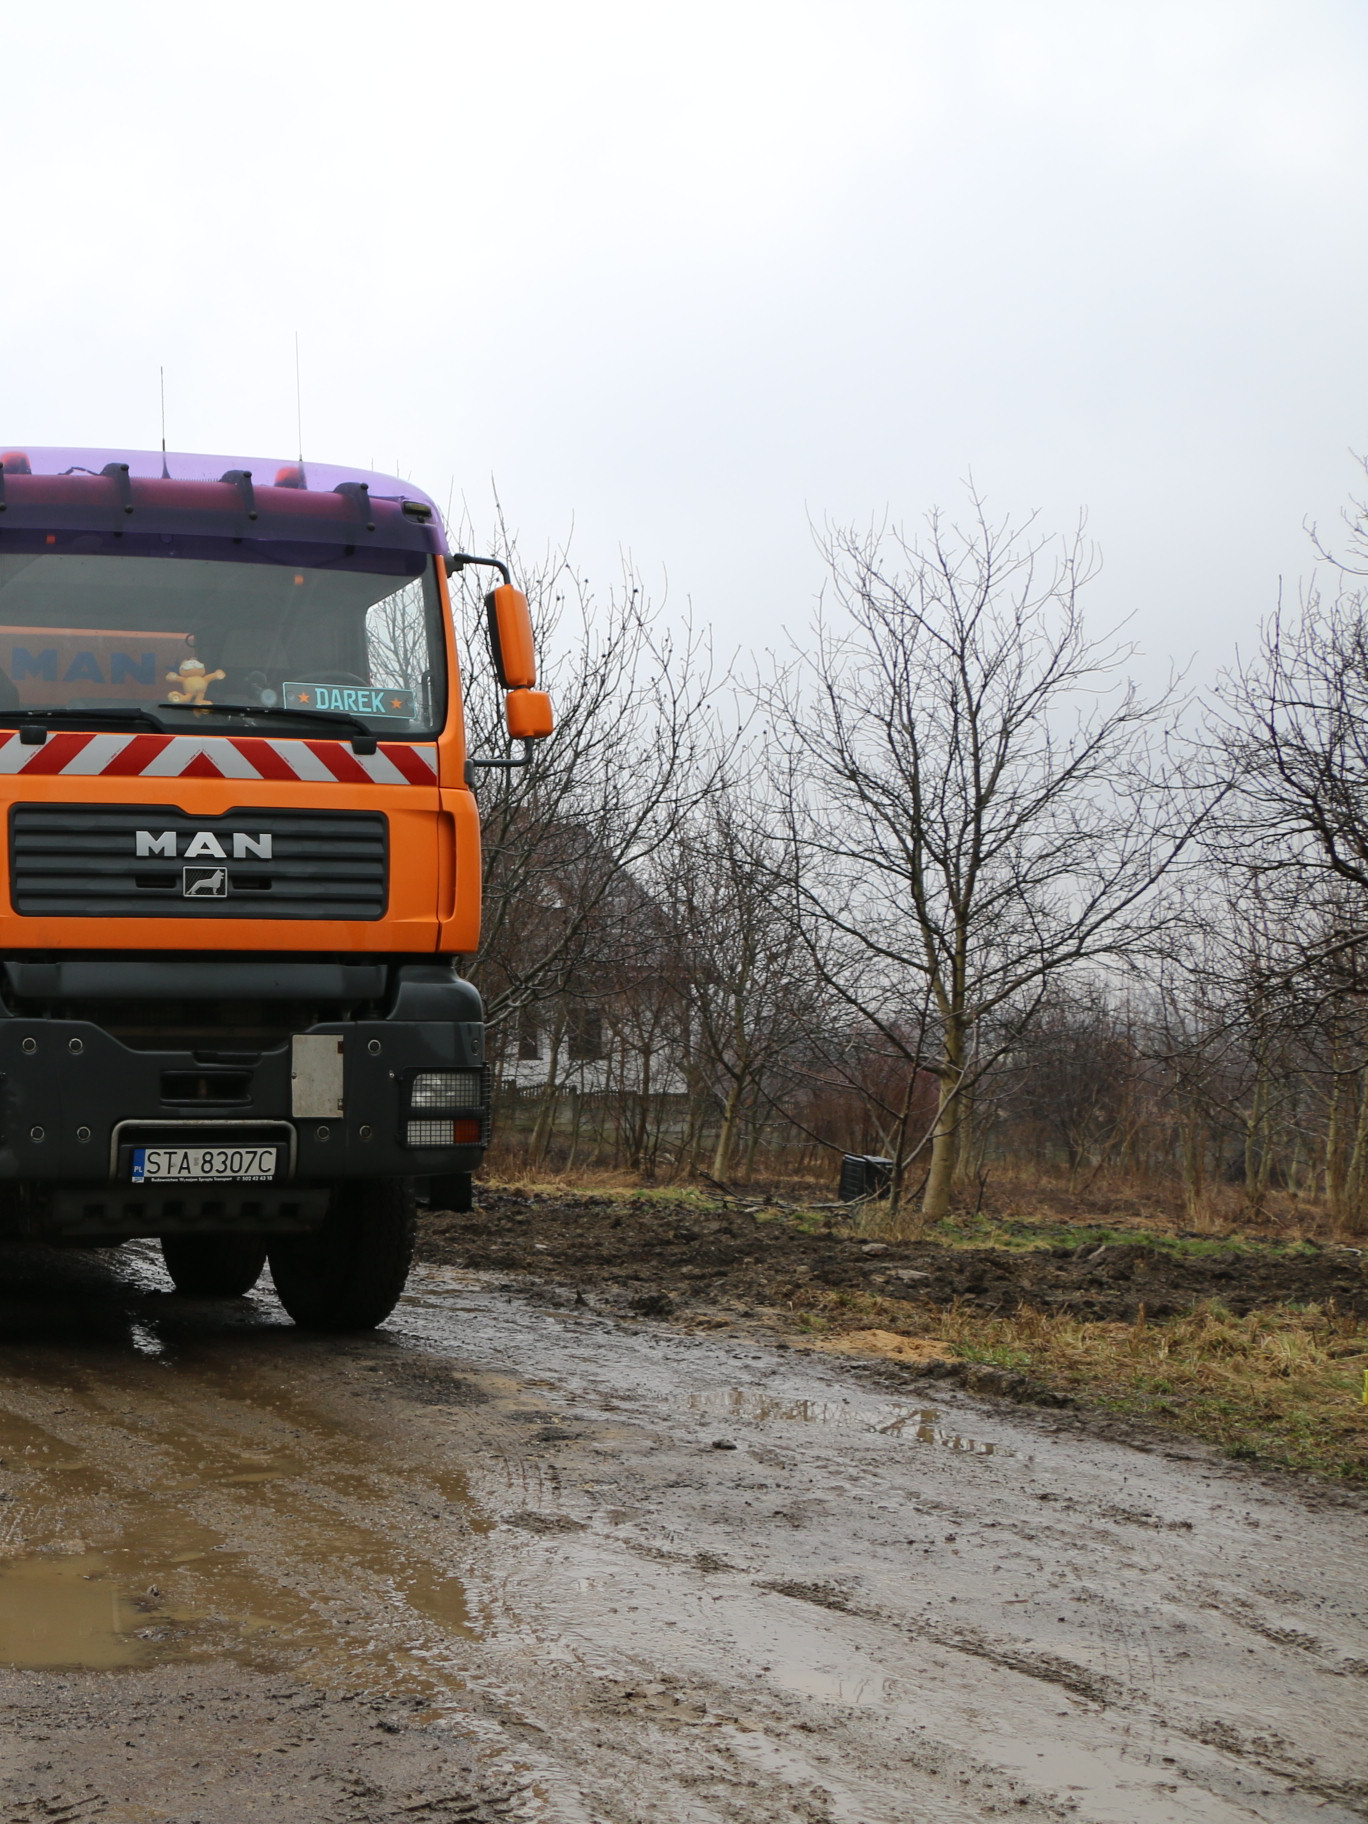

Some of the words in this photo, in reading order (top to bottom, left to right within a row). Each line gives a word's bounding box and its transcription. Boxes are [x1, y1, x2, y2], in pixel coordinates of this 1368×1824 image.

[11, 648, 157, 685] MAN
[315, 688, 386, 713] DAREK
[136, 831, 272, 858] MAN
[146, 1151, 191, 1174] STA
[201, 1150, 273, 1174] 8307C
